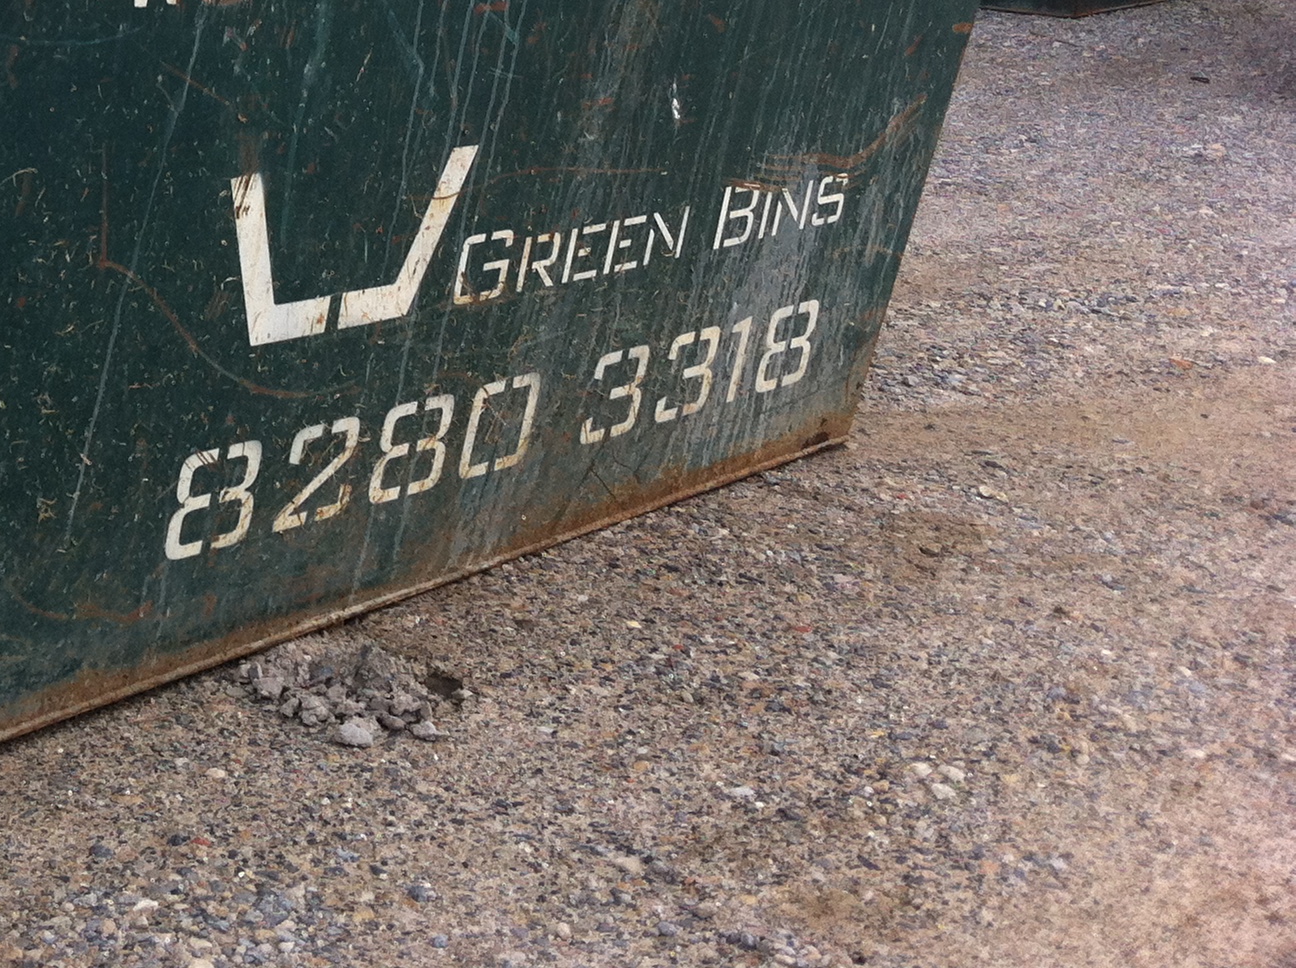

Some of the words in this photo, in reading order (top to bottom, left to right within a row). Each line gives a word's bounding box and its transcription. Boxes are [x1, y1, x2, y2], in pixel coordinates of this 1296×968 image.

[453, 206, 690, 305] GREEN
[713, 173, 850, 251] BINS
[164, 373, 540, 561] 8280
[580, 299, 820, 444] 3318
